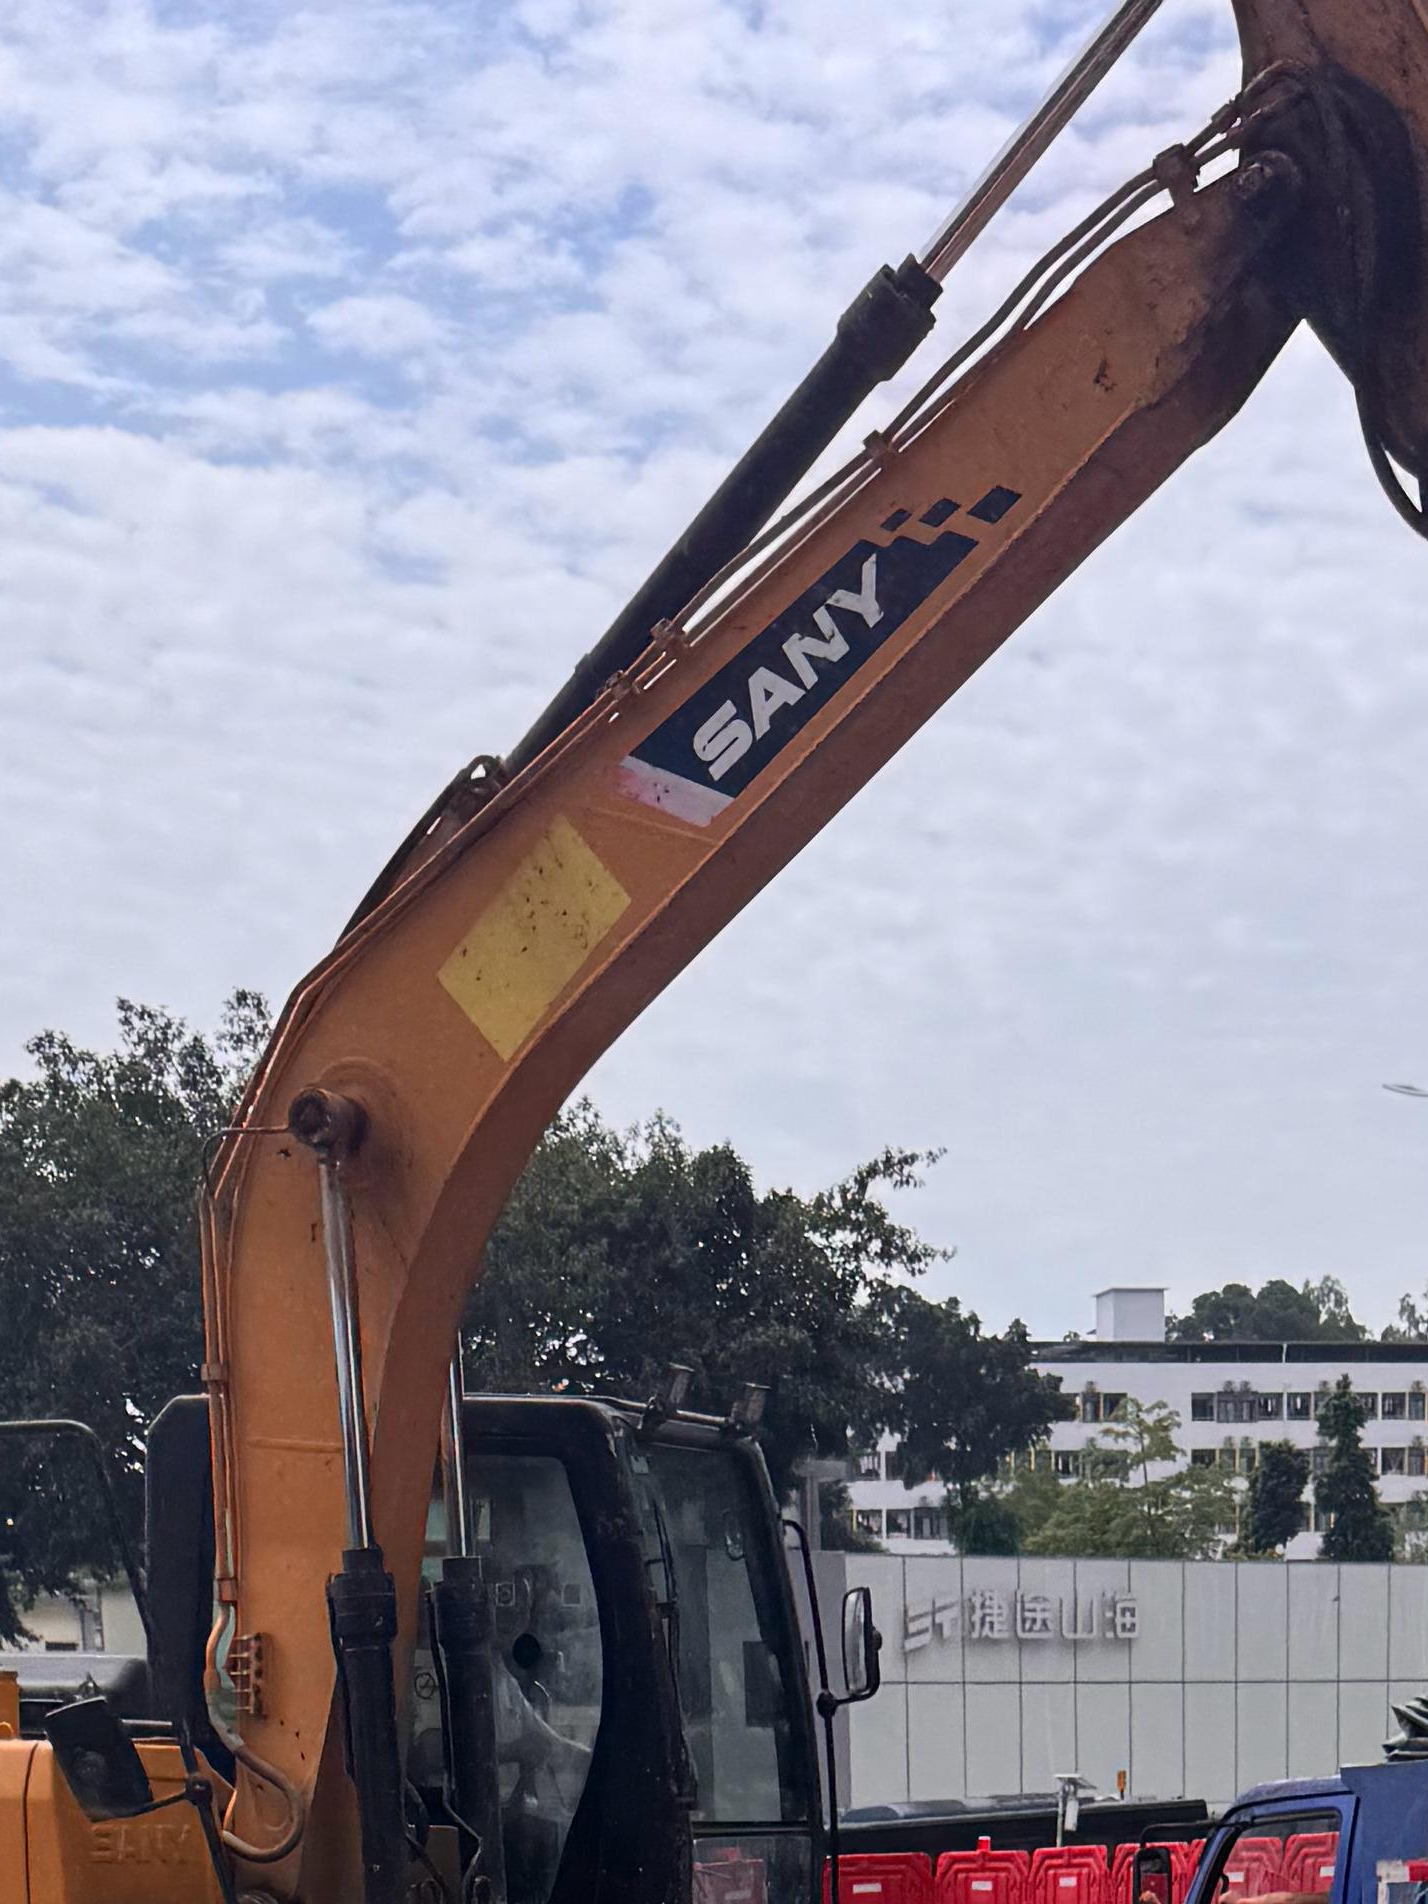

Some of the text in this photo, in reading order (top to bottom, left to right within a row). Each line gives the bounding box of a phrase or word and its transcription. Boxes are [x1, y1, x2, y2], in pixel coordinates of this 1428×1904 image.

[692, 552, 883, 782] SANY
[969, 1588, 1140, 1640] 捷途山海
